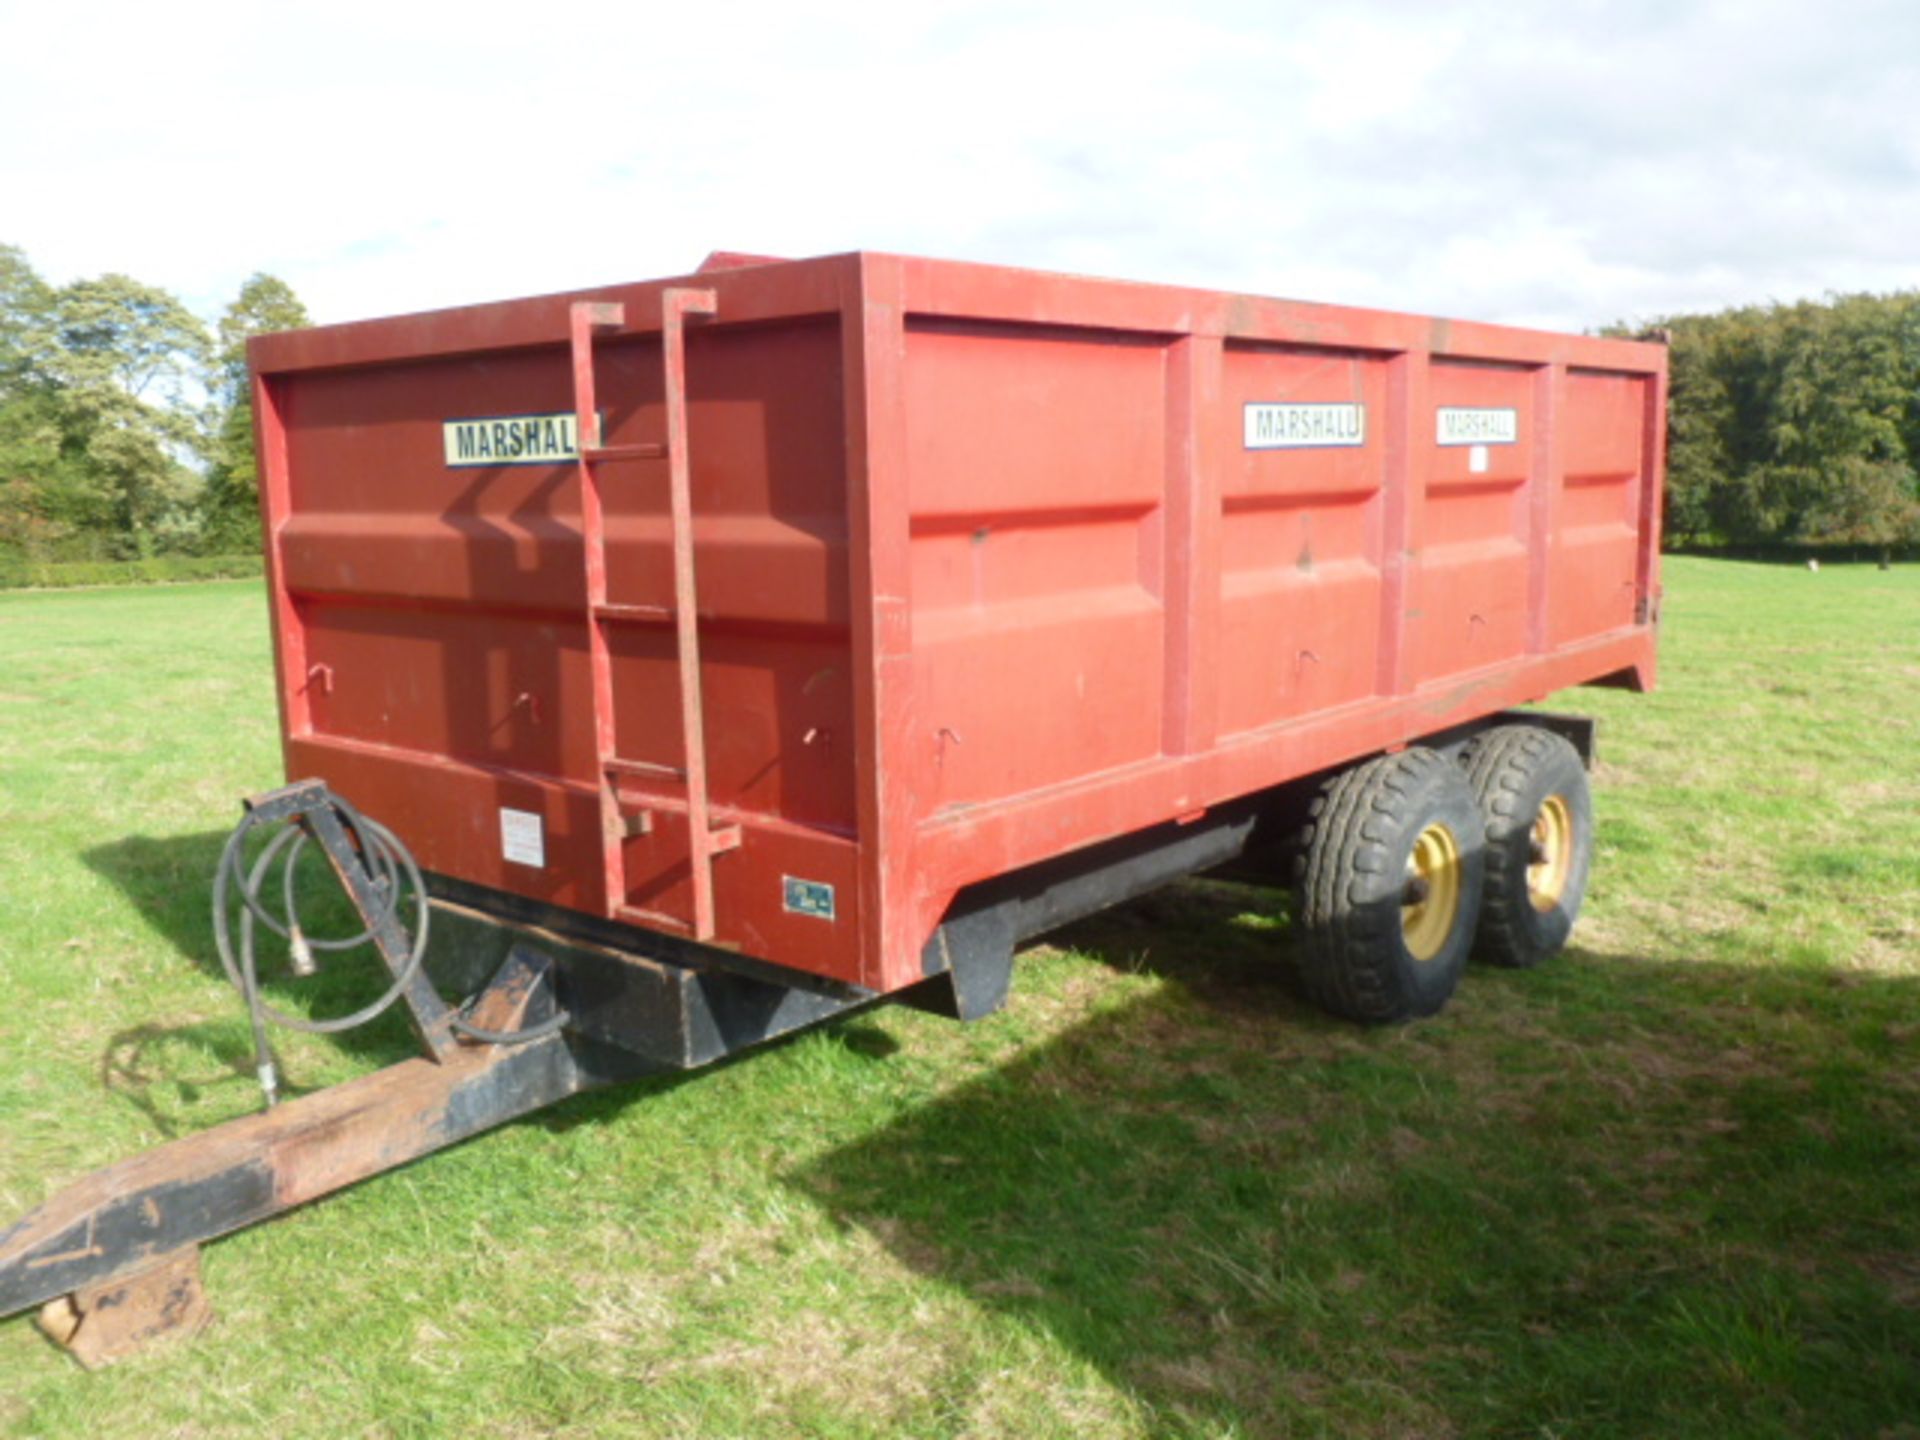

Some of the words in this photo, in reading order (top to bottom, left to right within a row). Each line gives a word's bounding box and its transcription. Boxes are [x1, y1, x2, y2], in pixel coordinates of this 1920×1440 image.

[457, 419, 576, 458] MARSHAL
[1257, 410, 1360, 439] MARSHALL
[1446, 413, 1510, 437] MARSHALL
